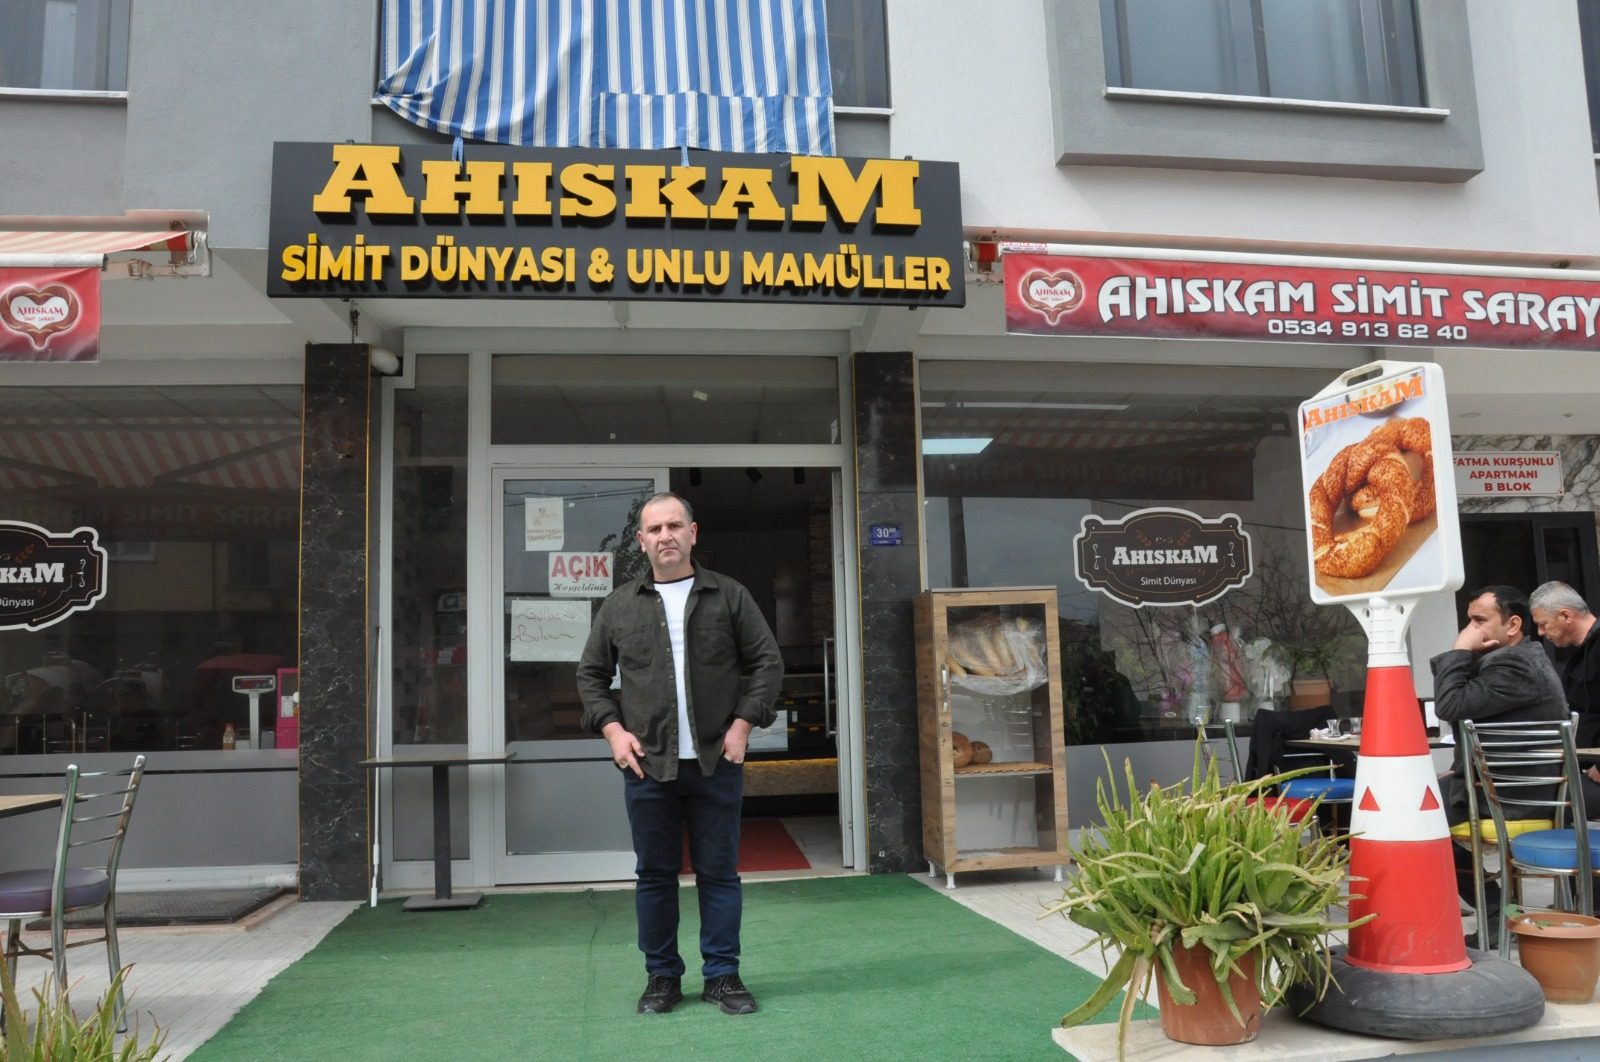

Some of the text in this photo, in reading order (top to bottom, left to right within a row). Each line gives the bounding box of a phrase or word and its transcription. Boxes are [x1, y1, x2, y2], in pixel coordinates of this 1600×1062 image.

[312, 145, 922, 226] AHISKAM
[281, 233, 951, 291] SİMİT DÜNYASI & UNLU MAMÜLLER
[1034, 288, 1073, 298] AHISKAM
[1098, 276, 1315, 323] AHISKAM
[1331, 276, 1449, 317] SİMİT
[16, 306, 64, 316] AHISKAM
[1267, 318, 1467, 340] 0534 913 62 40
[1306, 375, 1424, 429] AHISKAM
[1494, 457, 1555, 469] KURŞUNLU
[1469, 470, 1538, 480] APARTMANI
[1484, 482, 1532, 491] B BLOK
[1112, 546, 1219, 565] AHISKAM
[552, 555, 609, 583] AÇIK
[1140, 576, 1197, 587] Simit Dünyası
[0, 597, 34, 608] ünyası
